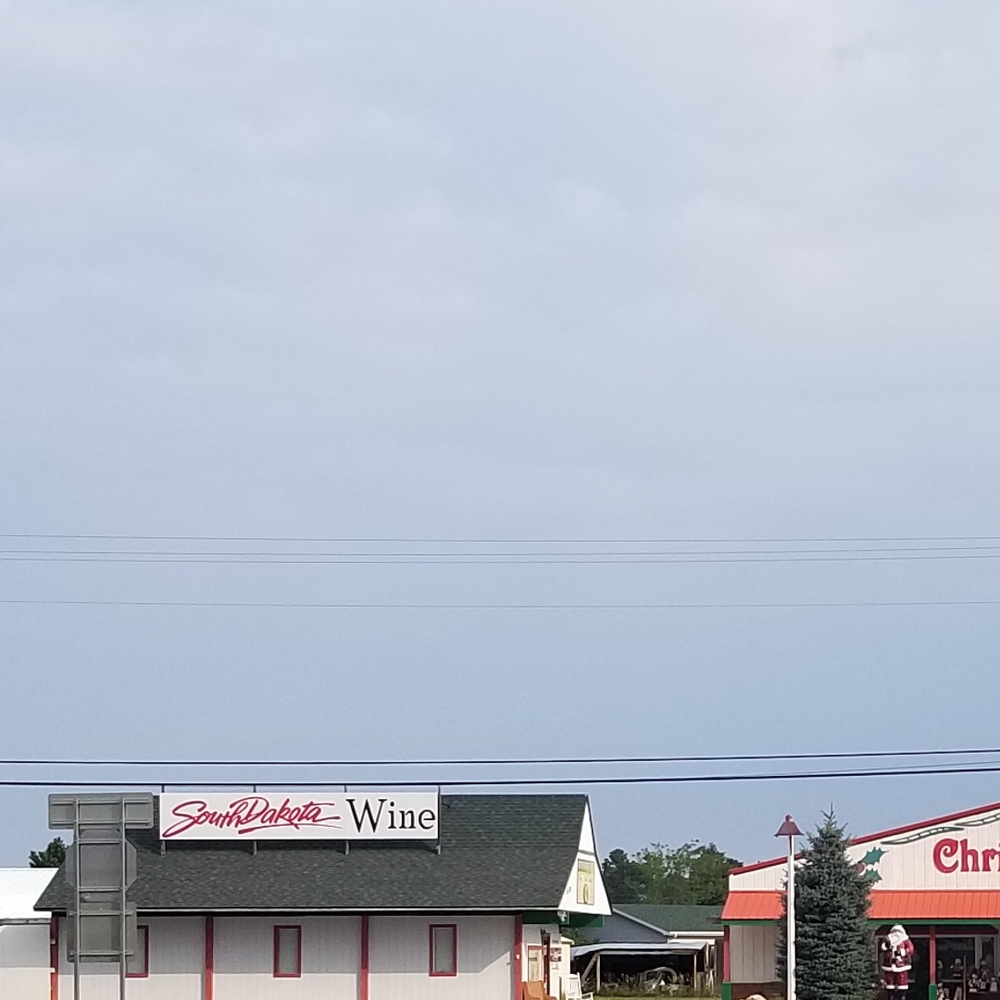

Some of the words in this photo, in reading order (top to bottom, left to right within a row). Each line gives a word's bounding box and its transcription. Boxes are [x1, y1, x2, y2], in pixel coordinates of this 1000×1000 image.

[162, 800, 247, 838] South
[230, 796, 342, 832] Dakota
[346, 798, 436, 834] Wine
